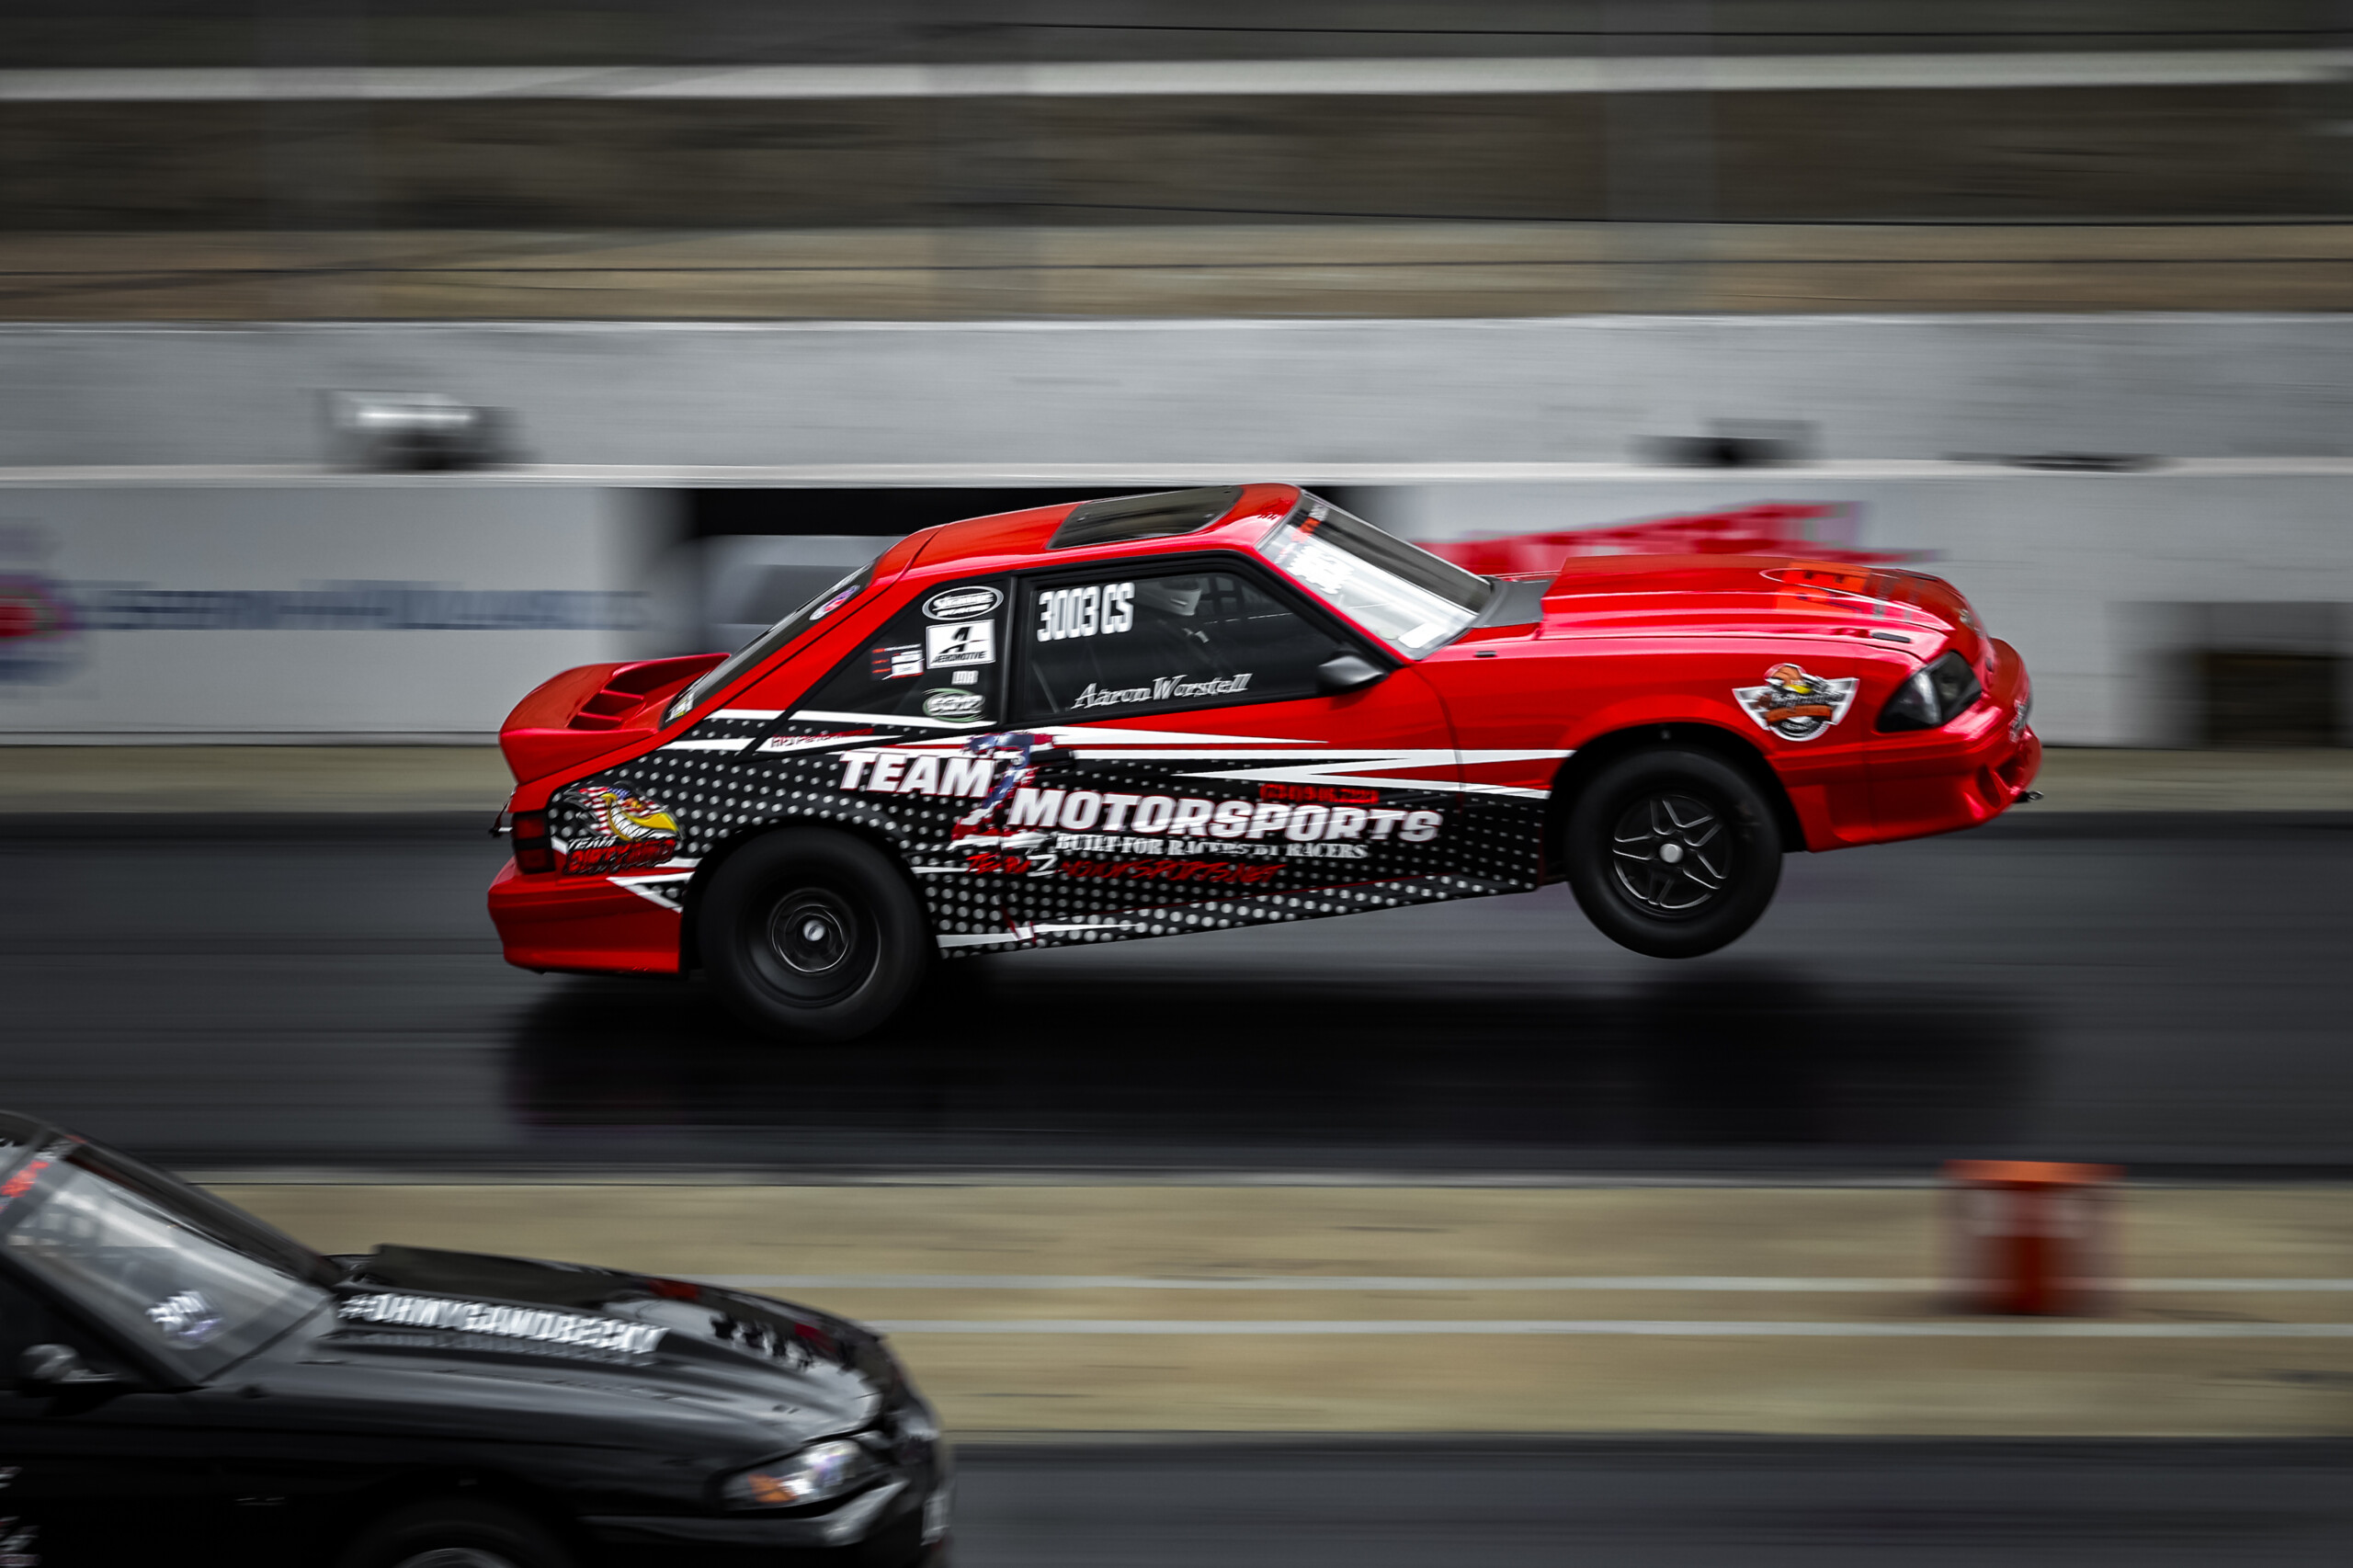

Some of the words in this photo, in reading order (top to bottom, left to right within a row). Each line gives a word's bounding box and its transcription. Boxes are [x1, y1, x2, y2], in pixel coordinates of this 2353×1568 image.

[1037, 585, 1100, 642] 3003
[1100, 582, 1135, 634] CS
[1070, 683, 1153, 709] Aaron
[1153, 673, 1254, 701] Worstell
[838, 751, 997, 798] TEAM
[1006, 788, 1443, 842] MOTORSPORTS
[568, 835, 620, 851] TEAM
[1055, 833, 1120, 852] BUILT
[1120, 836, 1164, 855] FOR
[1285, 843, 1369, 858] RACERS
